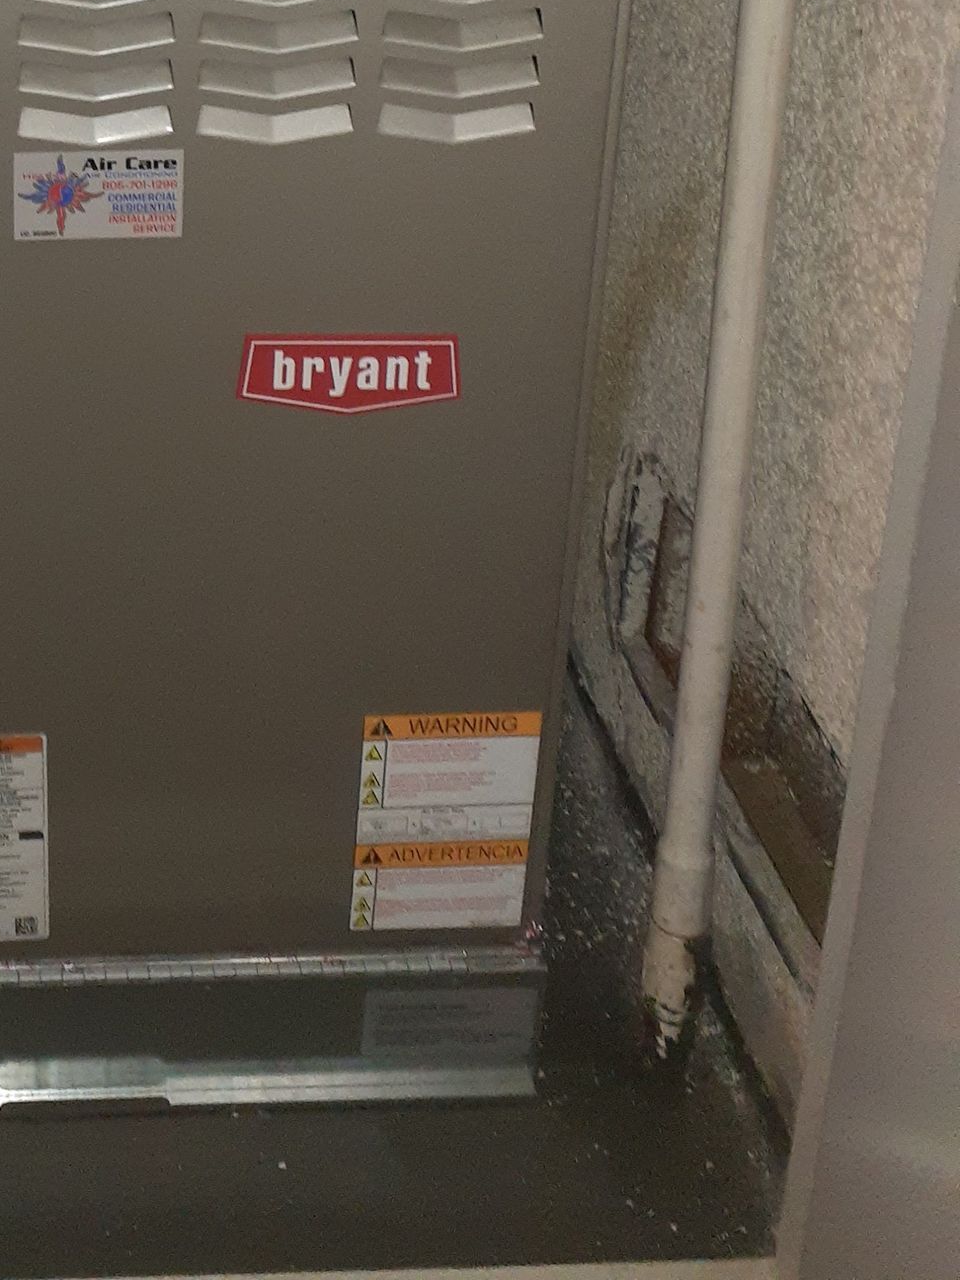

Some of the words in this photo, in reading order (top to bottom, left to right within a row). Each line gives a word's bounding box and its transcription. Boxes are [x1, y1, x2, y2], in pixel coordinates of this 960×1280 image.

[82, 157, 117, 171] Air
[125, 156, 178, 171] Care
[107, 192, 177, 202] COMMERCIAL
[112, 202, 177, 213] RESIDENTIAL
[108, 214, 177, 224] INSTALLATION
[132, 223, 177, 234] SERVICE
[272, 349, 432, 398] bryant
[409, 715, 518, 734] WARNING
[388, 844, 524, 863] ADVERTENCIA
